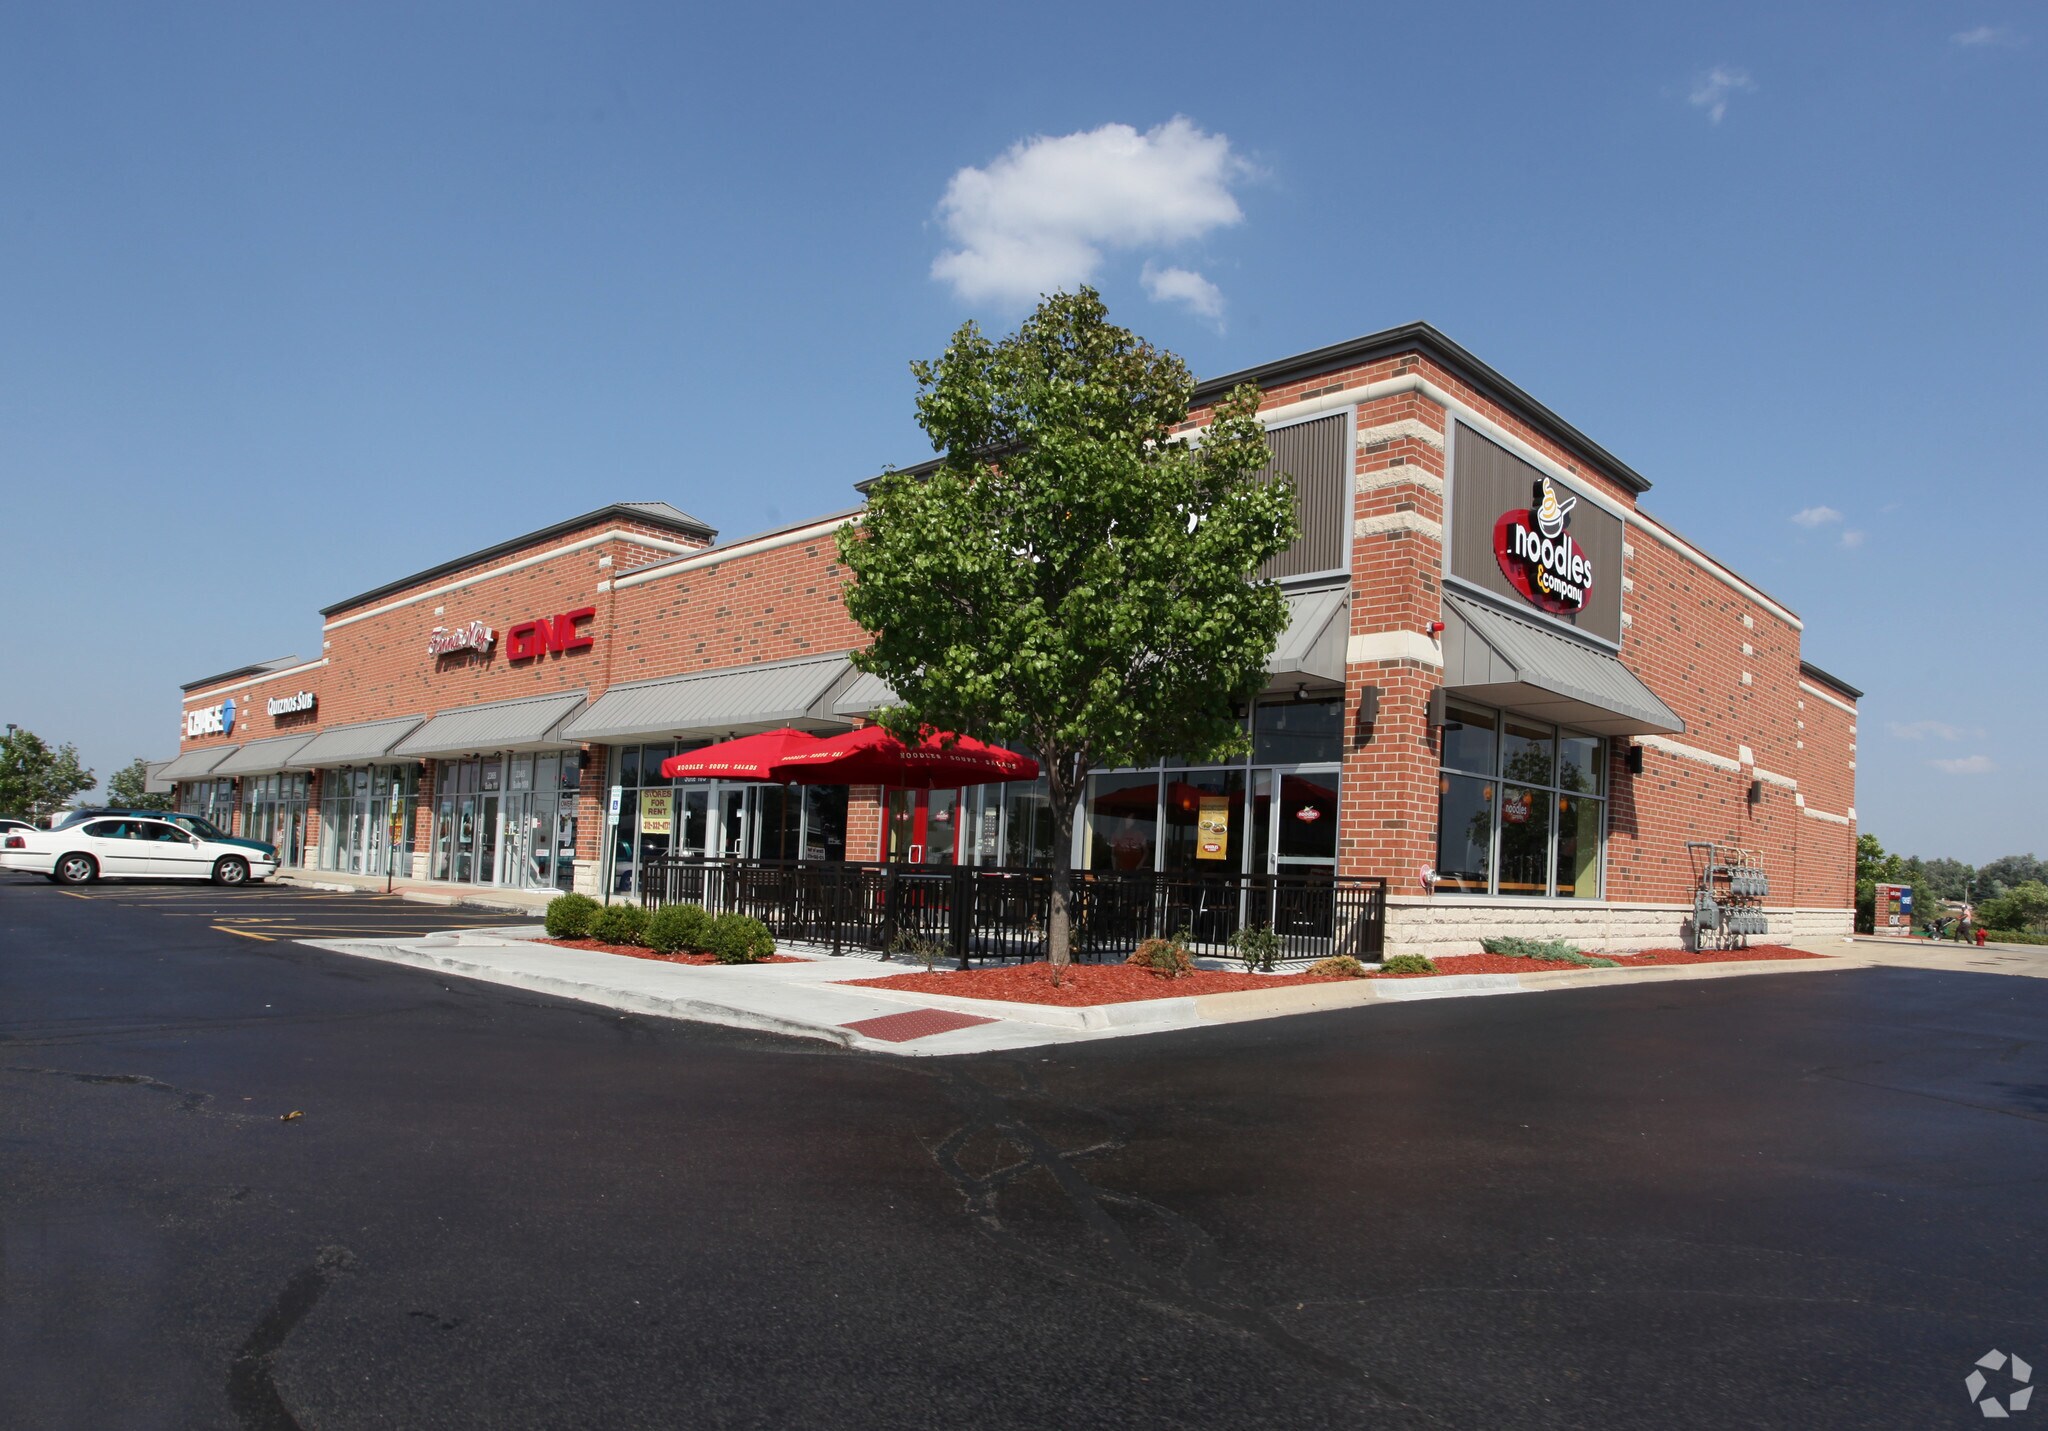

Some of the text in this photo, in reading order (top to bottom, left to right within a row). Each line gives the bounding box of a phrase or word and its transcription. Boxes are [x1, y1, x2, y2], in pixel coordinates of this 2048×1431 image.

[1515, 523, 1592, 589] noodles
[1537, 564, 1583, 608] & company
[506, 606, 596, 660] GNC
[188, 704, 224, 736] CHASE
[676, 763, 704, 771] NOODLES
[900, 752, 1017, 770] NOODLES SOUPS SALADS
[643, 789, 672, 798] STORES
[650, 799, 665, 807] FOR
[1506, 802, 1527, 815] noodles
[647, 808, 667, 816] RENT
